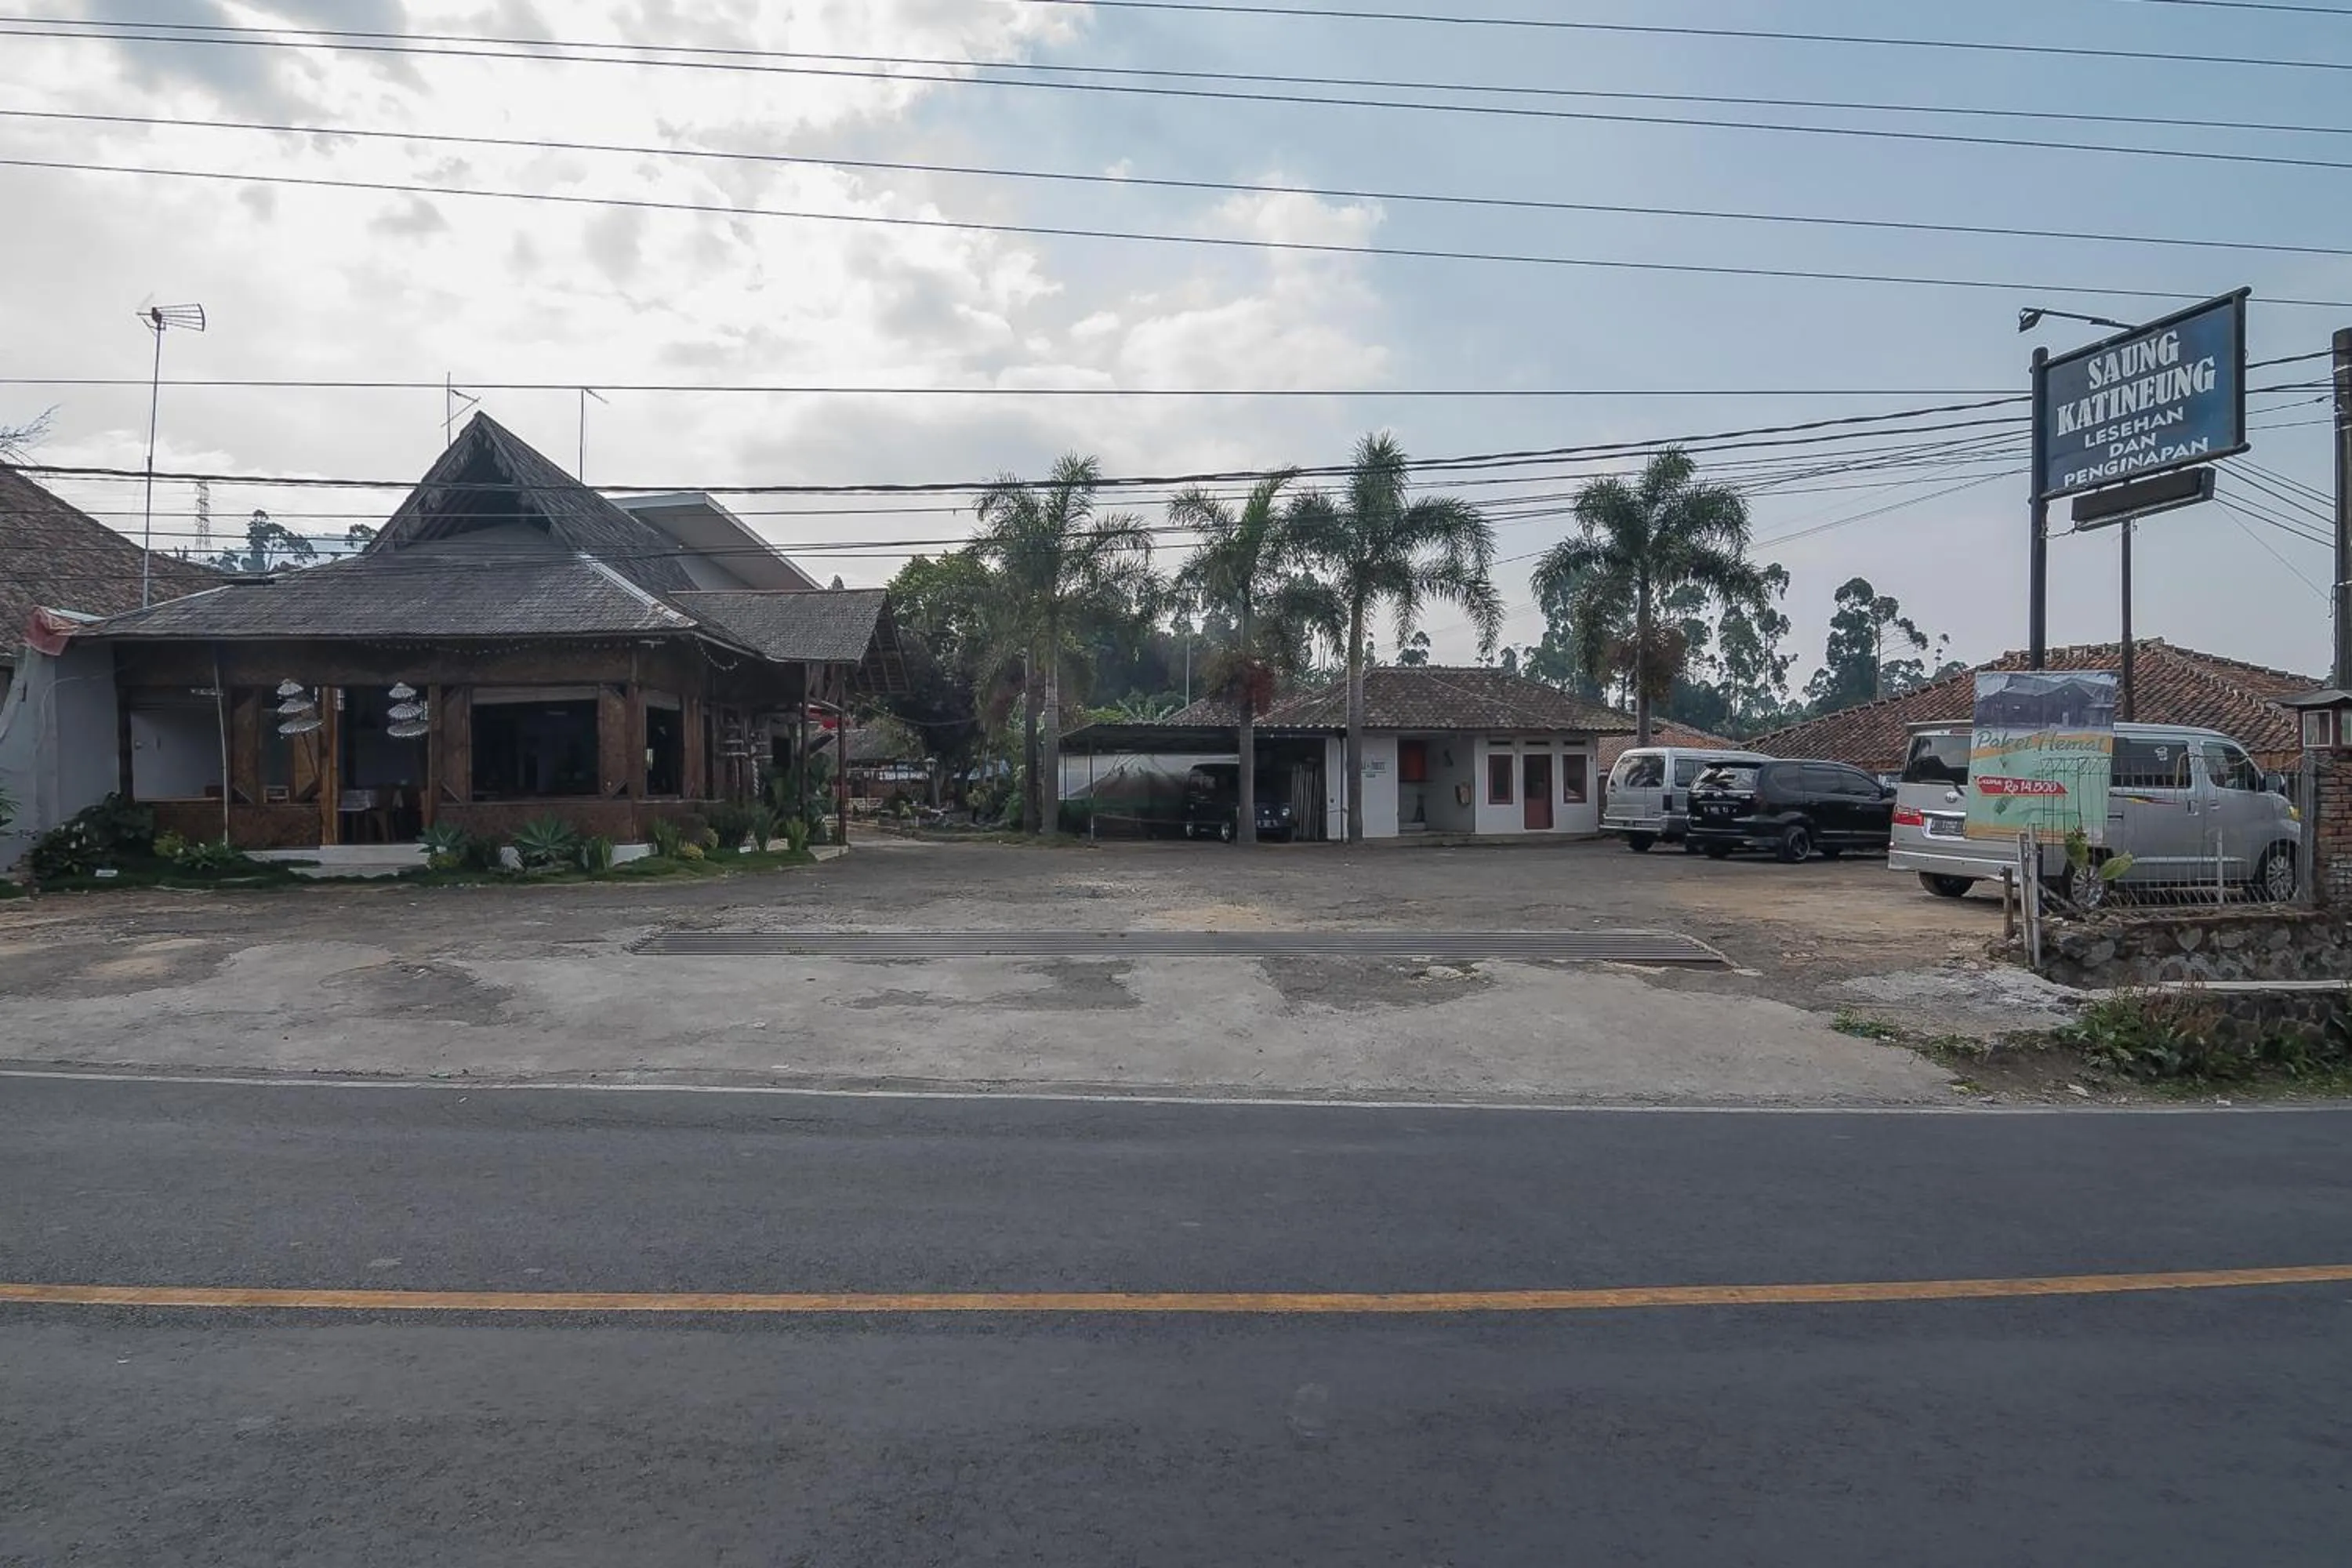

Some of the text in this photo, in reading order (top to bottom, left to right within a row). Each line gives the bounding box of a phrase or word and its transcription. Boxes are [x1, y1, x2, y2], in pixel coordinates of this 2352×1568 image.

[2087, 329, 2180, 390] SAUNG
[2056, 356, 2216, 437] KATINEUNG
[2084, 406, 2184, 448] LESEHAN
[2109, 432, 2156, 459] DAN
[2063, 437, 2209, 488] PENGINAPAN
[1975, 728, 2106, 752] Paket Hemat
